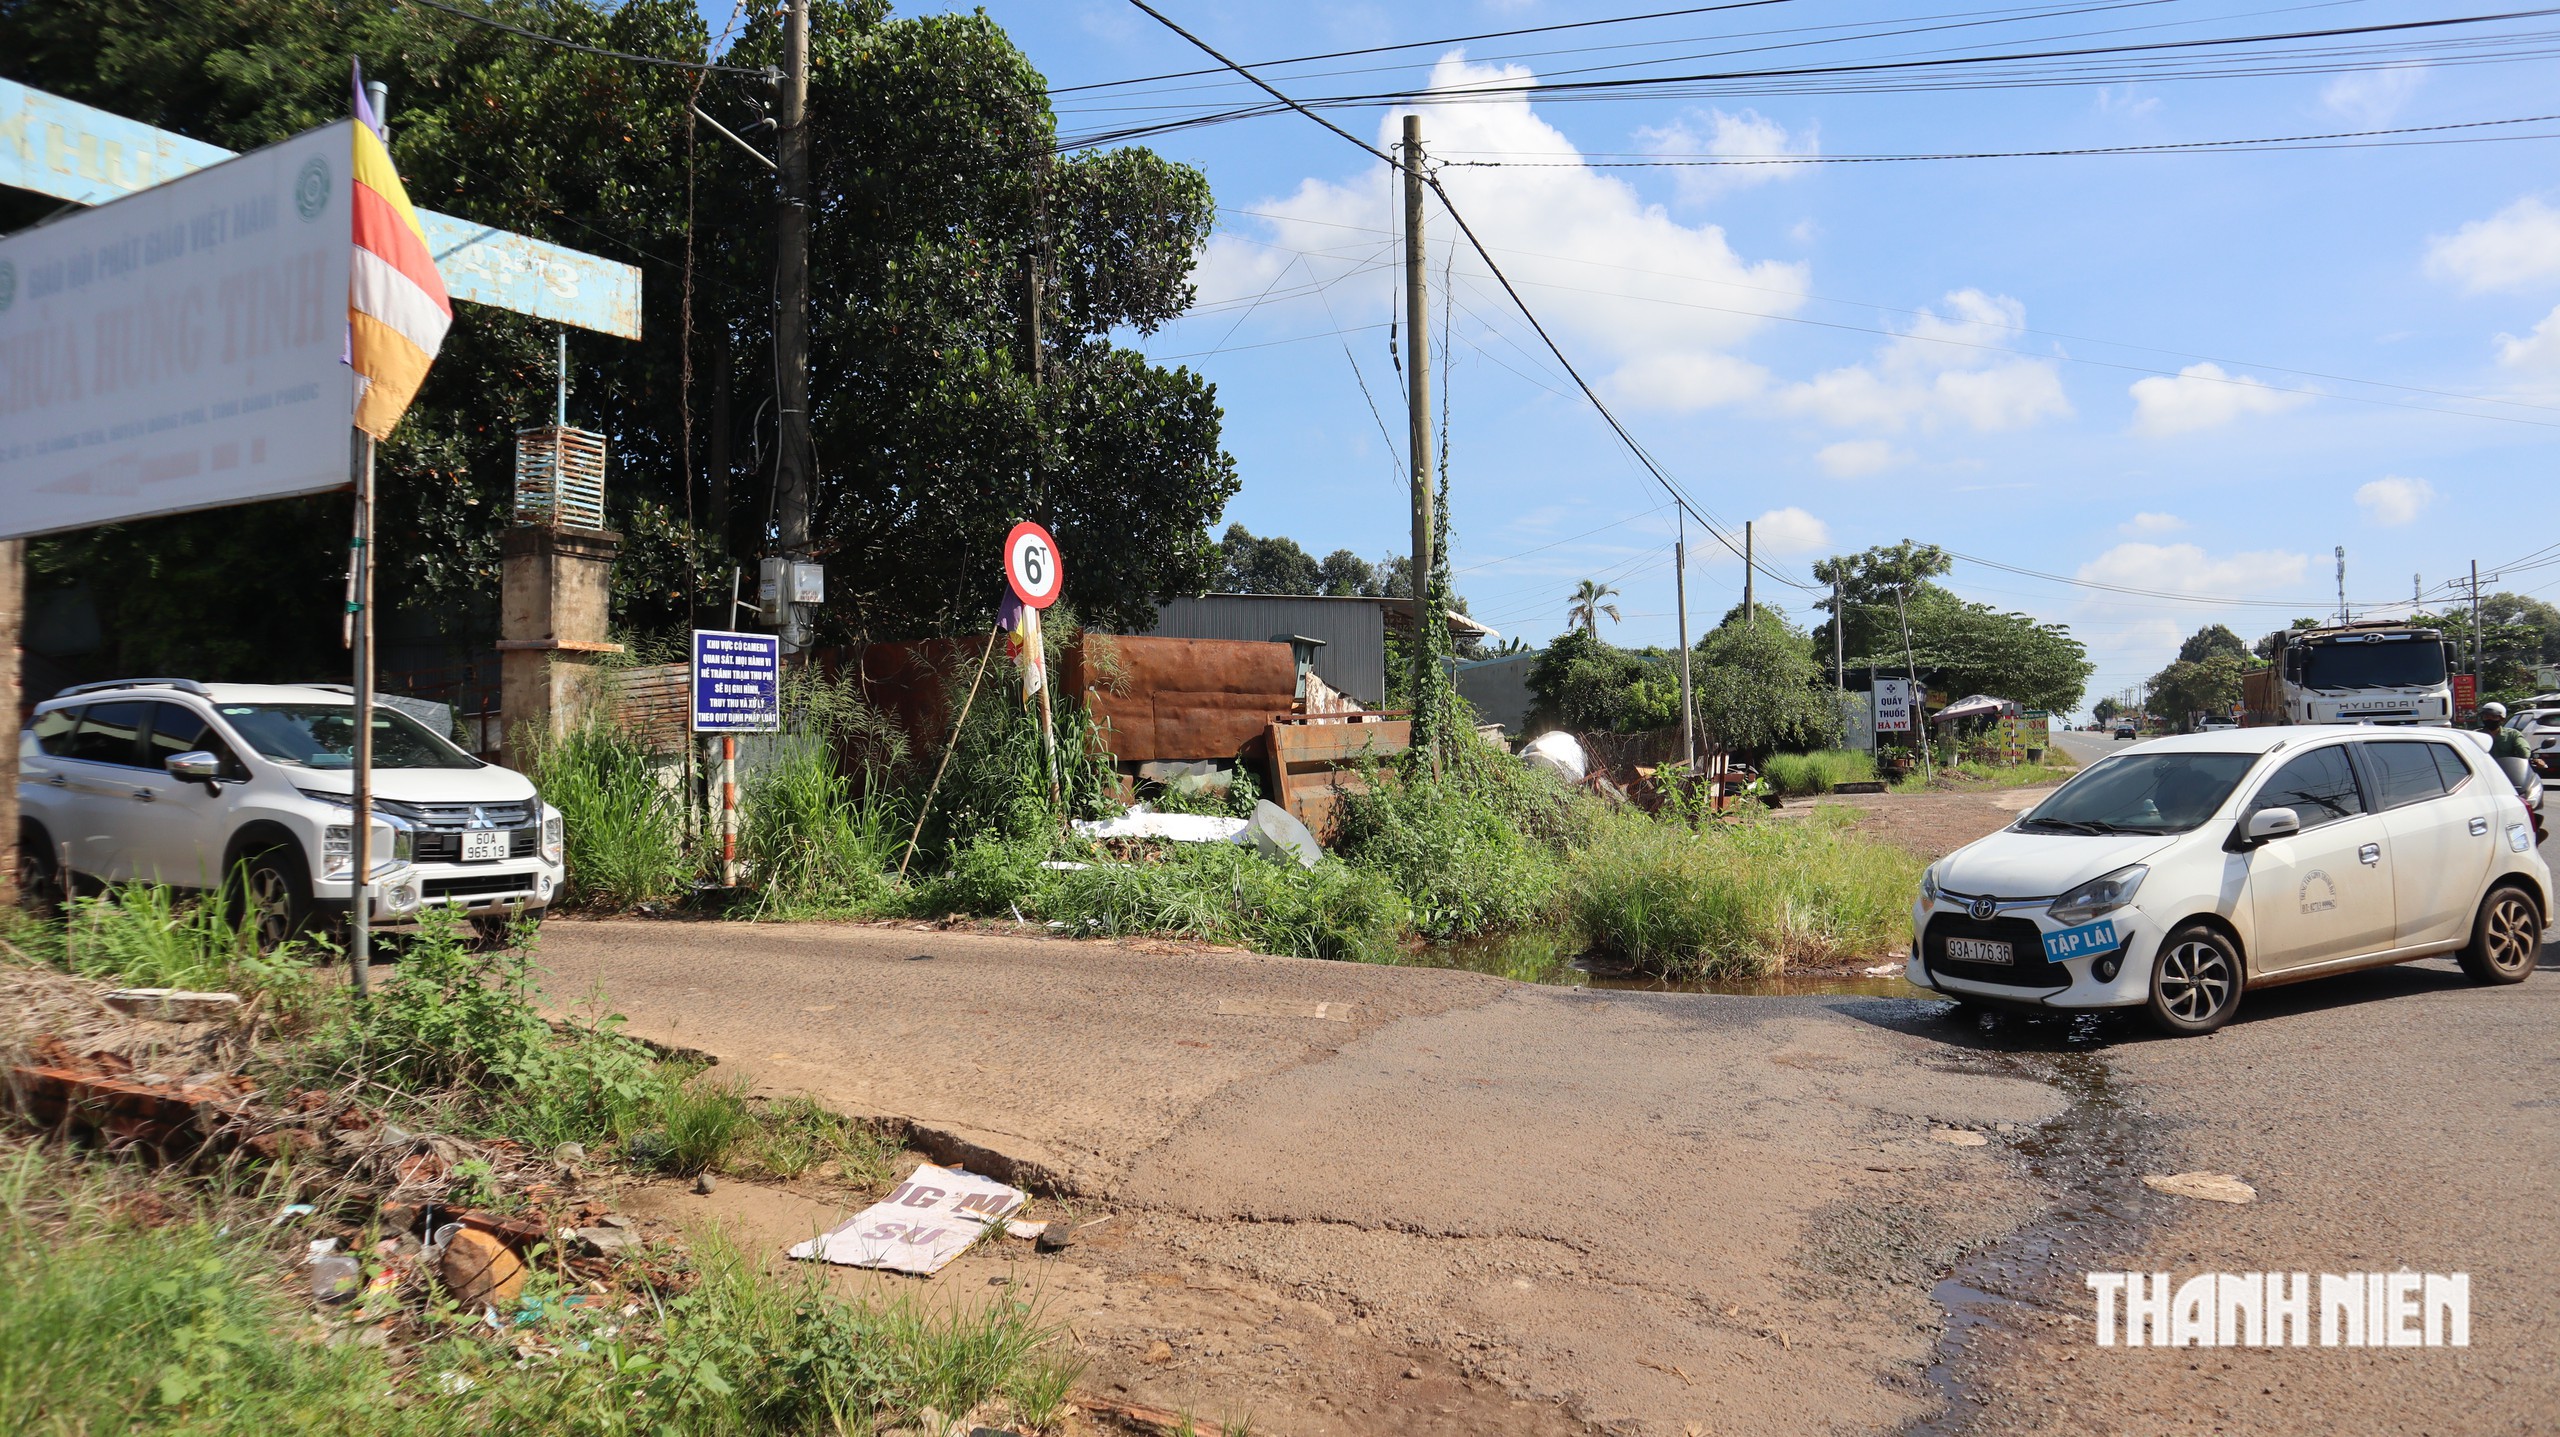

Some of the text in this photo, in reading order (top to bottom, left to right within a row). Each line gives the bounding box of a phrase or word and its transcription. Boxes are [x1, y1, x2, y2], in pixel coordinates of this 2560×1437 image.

[190, 203, 228, 254] VIỆT
[543, 262, 579, 299] 3
[707, 640, 768, 652] KHU VỰC CÓ CAMERA
[703, 654, 771, 667] QUAN SÁT. MỌI HÀNH VI
[701, 667, 773, 681] NÉ TRÁNH TRẠM THU PHÍ
[715, 683, 760, 695] SẼ BỊ GHI HÌNH,
[710, 697, 765, 708] TRUY THU VÀ XỬ LÝ
[2339, 701, 2415, 710] HYUNDAI
[698, 712, 775, 724] THEO QUY ĐỊNH PHÁP LUẬT
[1879, 708, 1906, 718] THUỐC
[1878, 720, 1890, 730] HÀ
[476, 833, 496, 845] 60A
[467, 845, 505, 859] 965.19
[2047, 926, 2113, 957] TẬP LÁI
[1949, 940, 2010, 961] 93A-176.36
[862, 1222, 946, 1246] SU
